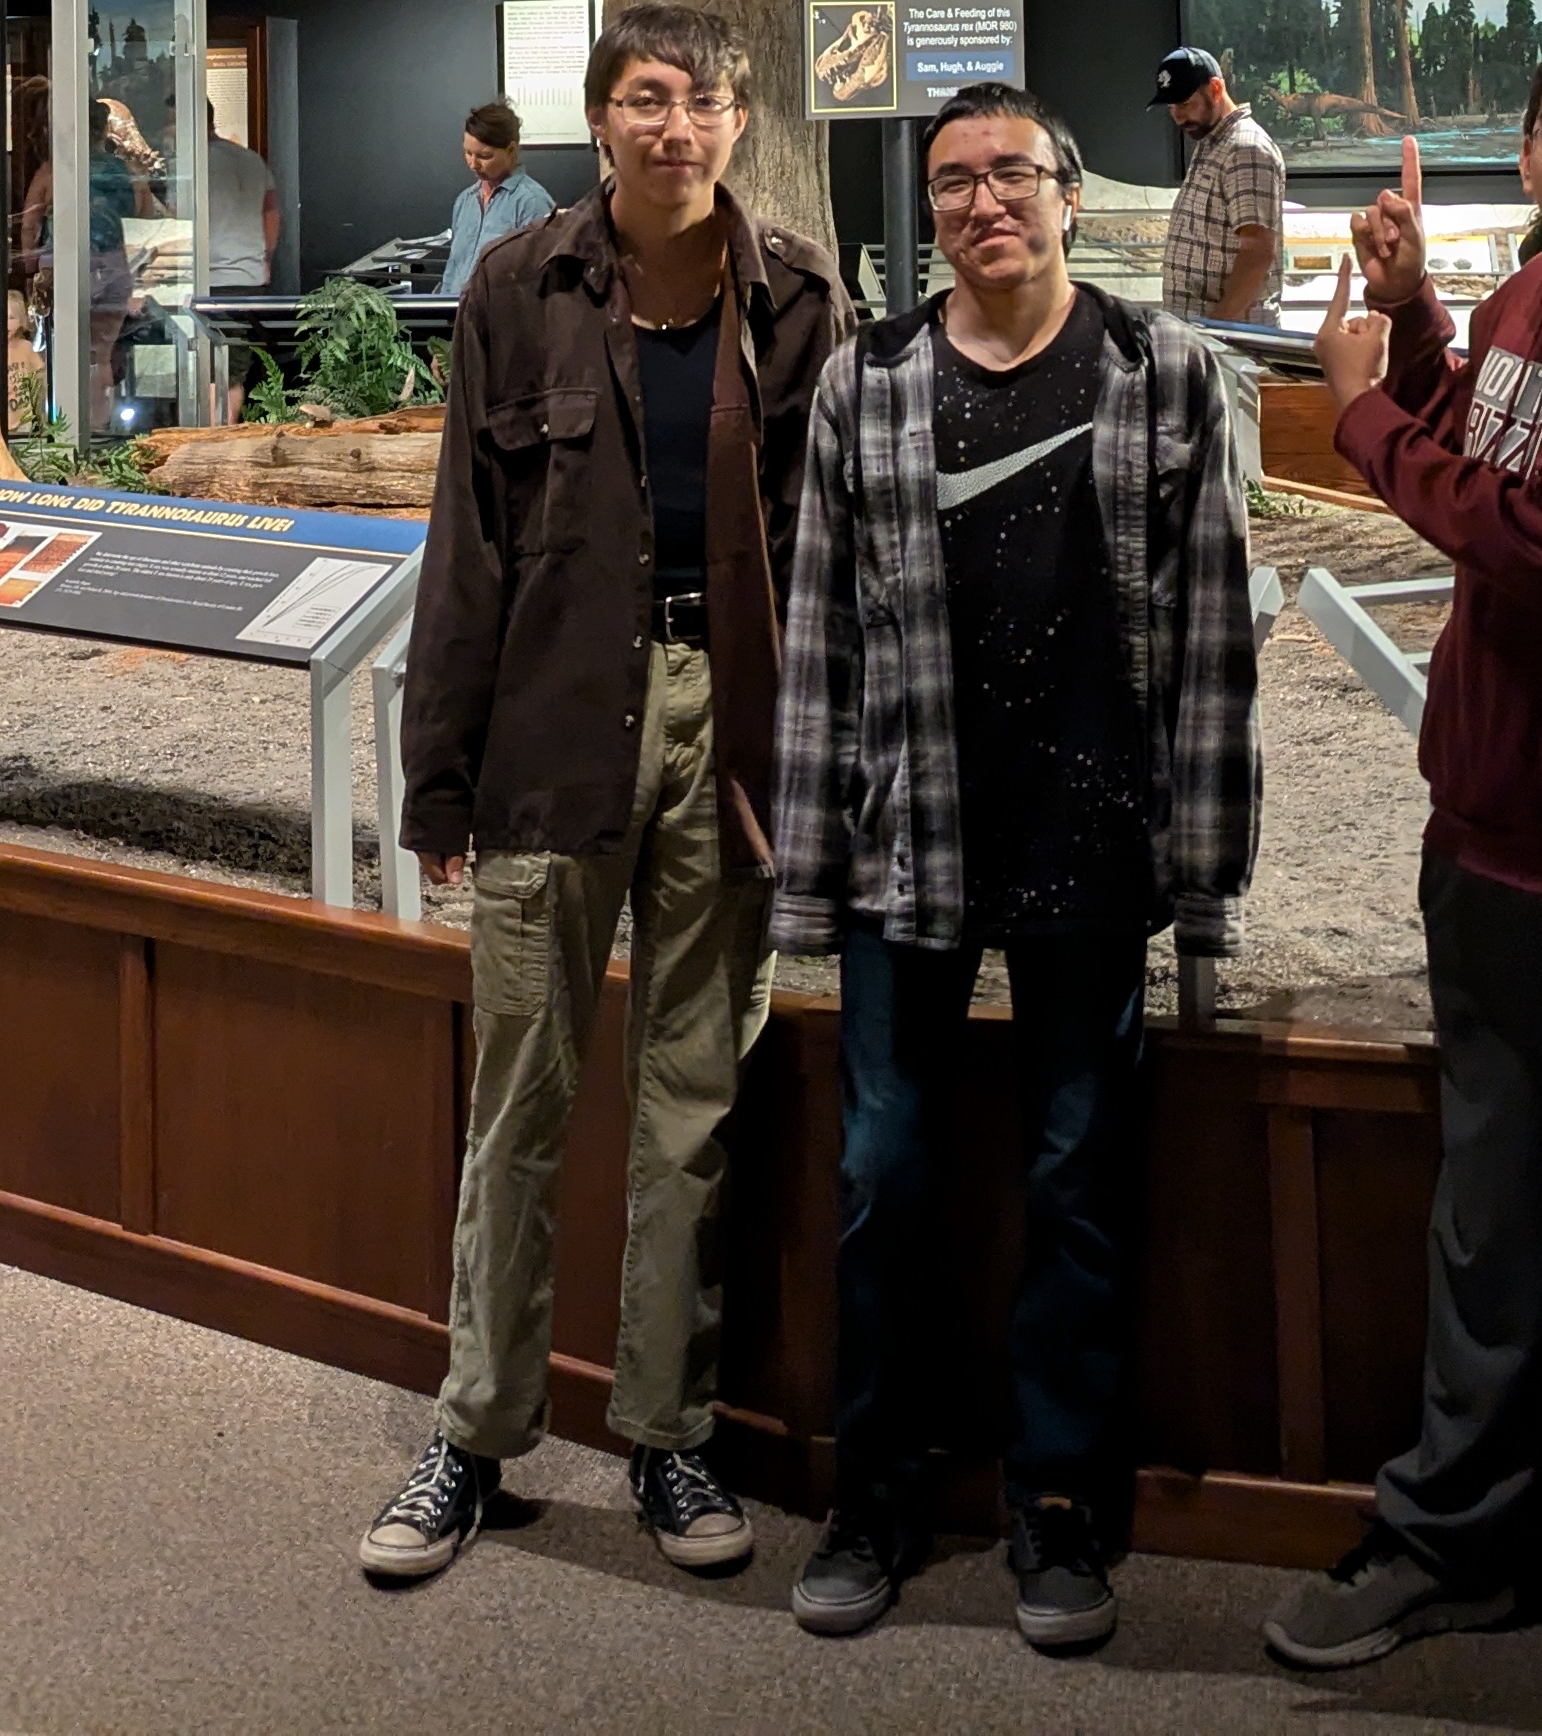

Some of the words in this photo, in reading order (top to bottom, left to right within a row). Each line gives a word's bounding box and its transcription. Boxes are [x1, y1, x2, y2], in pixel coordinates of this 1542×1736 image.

[909, 8, 925, 18] The
[926, 8, 945, 18] Care
[947, 8, 953, 18] &
[954, 8, 986, 20] Feeding
[987, 8, 996, 18] of
[996, 8, 1011, 17] this
[903, 21, 959, 34] Tyrannosaurus
[975, 21, 998, 32] (MOR
[906, 36, 914, 46] is
[916, 35, 959, 48] generously
[959, 35, 1000, 46] sponsored
[1001, 35, 1013, 46] by:
[917, 62, 939, 73] Sam,
[940, 62, 965, 74] Hugh,
[967, 61, 973, 71] &
[975, 61, 1004, 73] Auggie
[27, 493, 75, 509] LONG
[72, 498, 105, 512] DID
[104, 500, 249, 528] TYRANNOSAURUS
